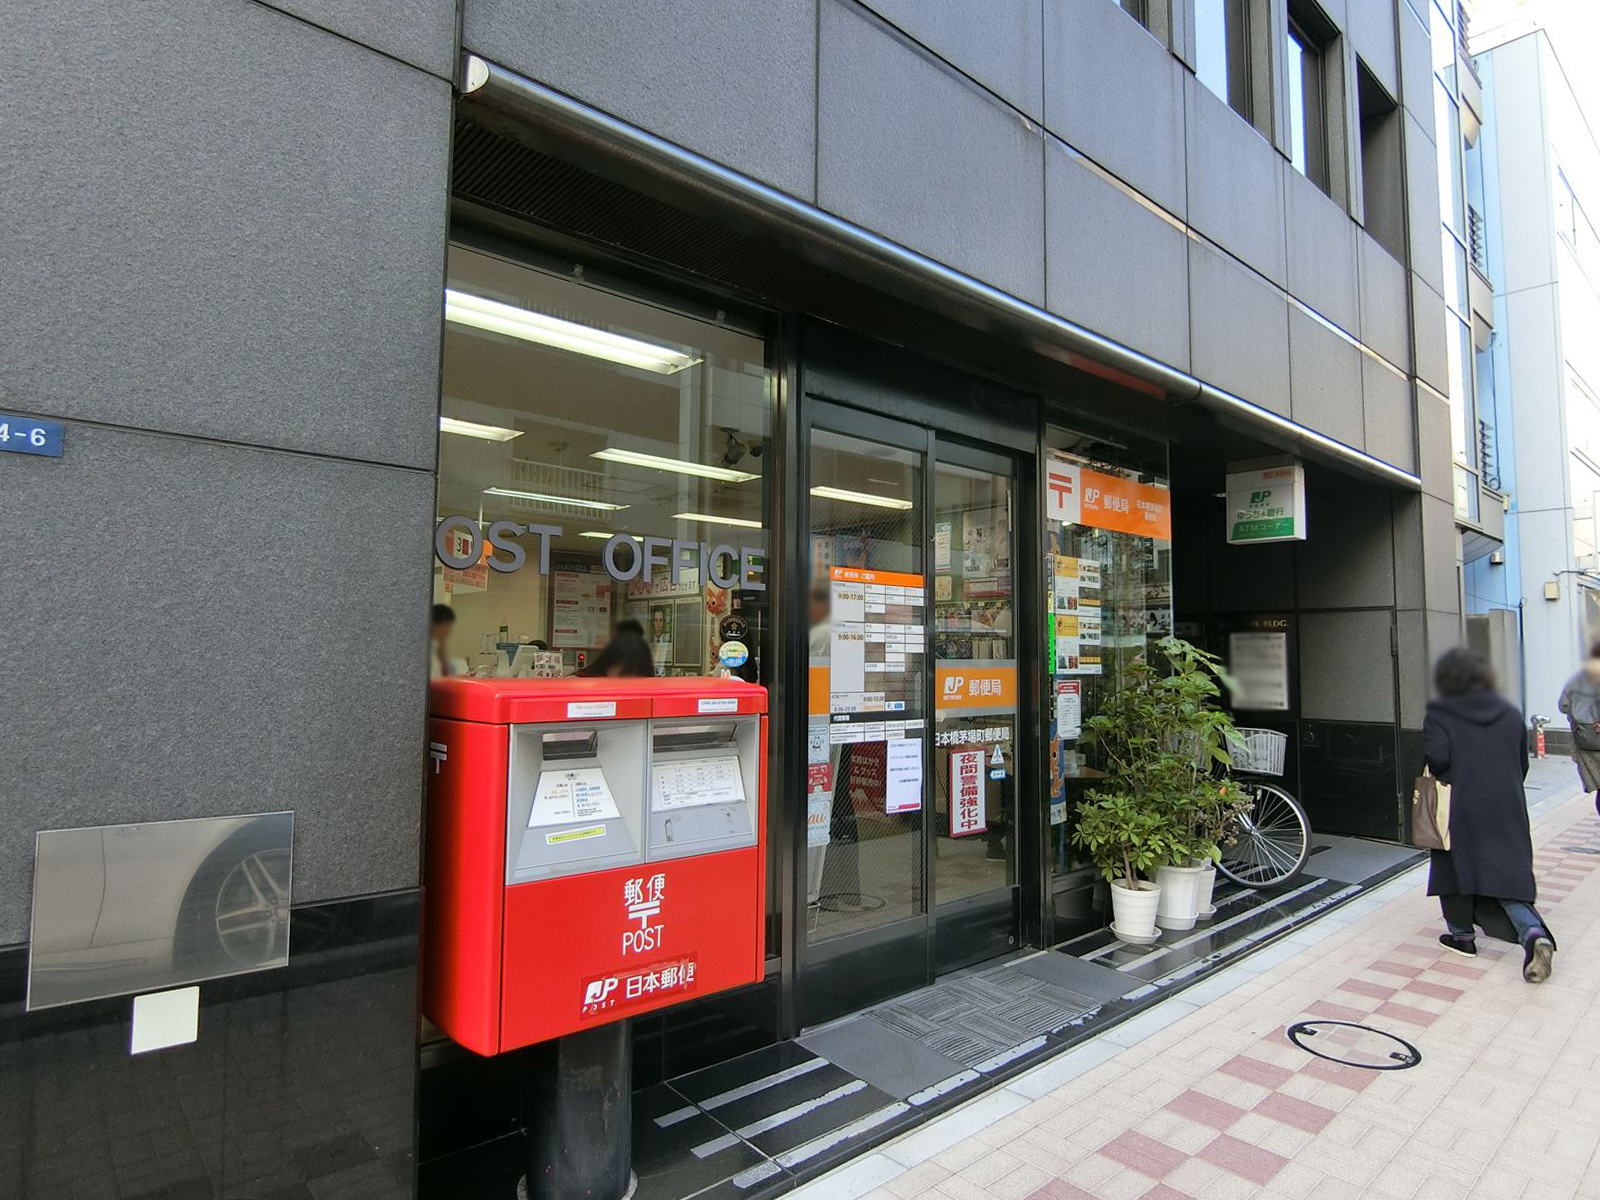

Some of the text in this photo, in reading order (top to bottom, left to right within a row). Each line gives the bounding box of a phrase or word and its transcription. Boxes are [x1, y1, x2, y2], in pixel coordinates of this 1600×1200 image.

[1103, 494, 1130, 514] 郵便局
[1237, 508, 1285, 519] ゆうちょ銀行
[1239, 522, 1292, 533] ATMコーナー
[603, 532, 767, 591] OFFICE
[968, 679, 1002, 696] 郵便局
[935, 727, 1010, 747] 日本橋茅場町郵便局
[959, 753, 979, 829] 夜間警備強化中
[624, 873, 666, 906] 郵便
[622, 925, 664, 955] POST
[626, 962, 695, 999] 日本郵便
[582, 999, 616, 1013] POST
